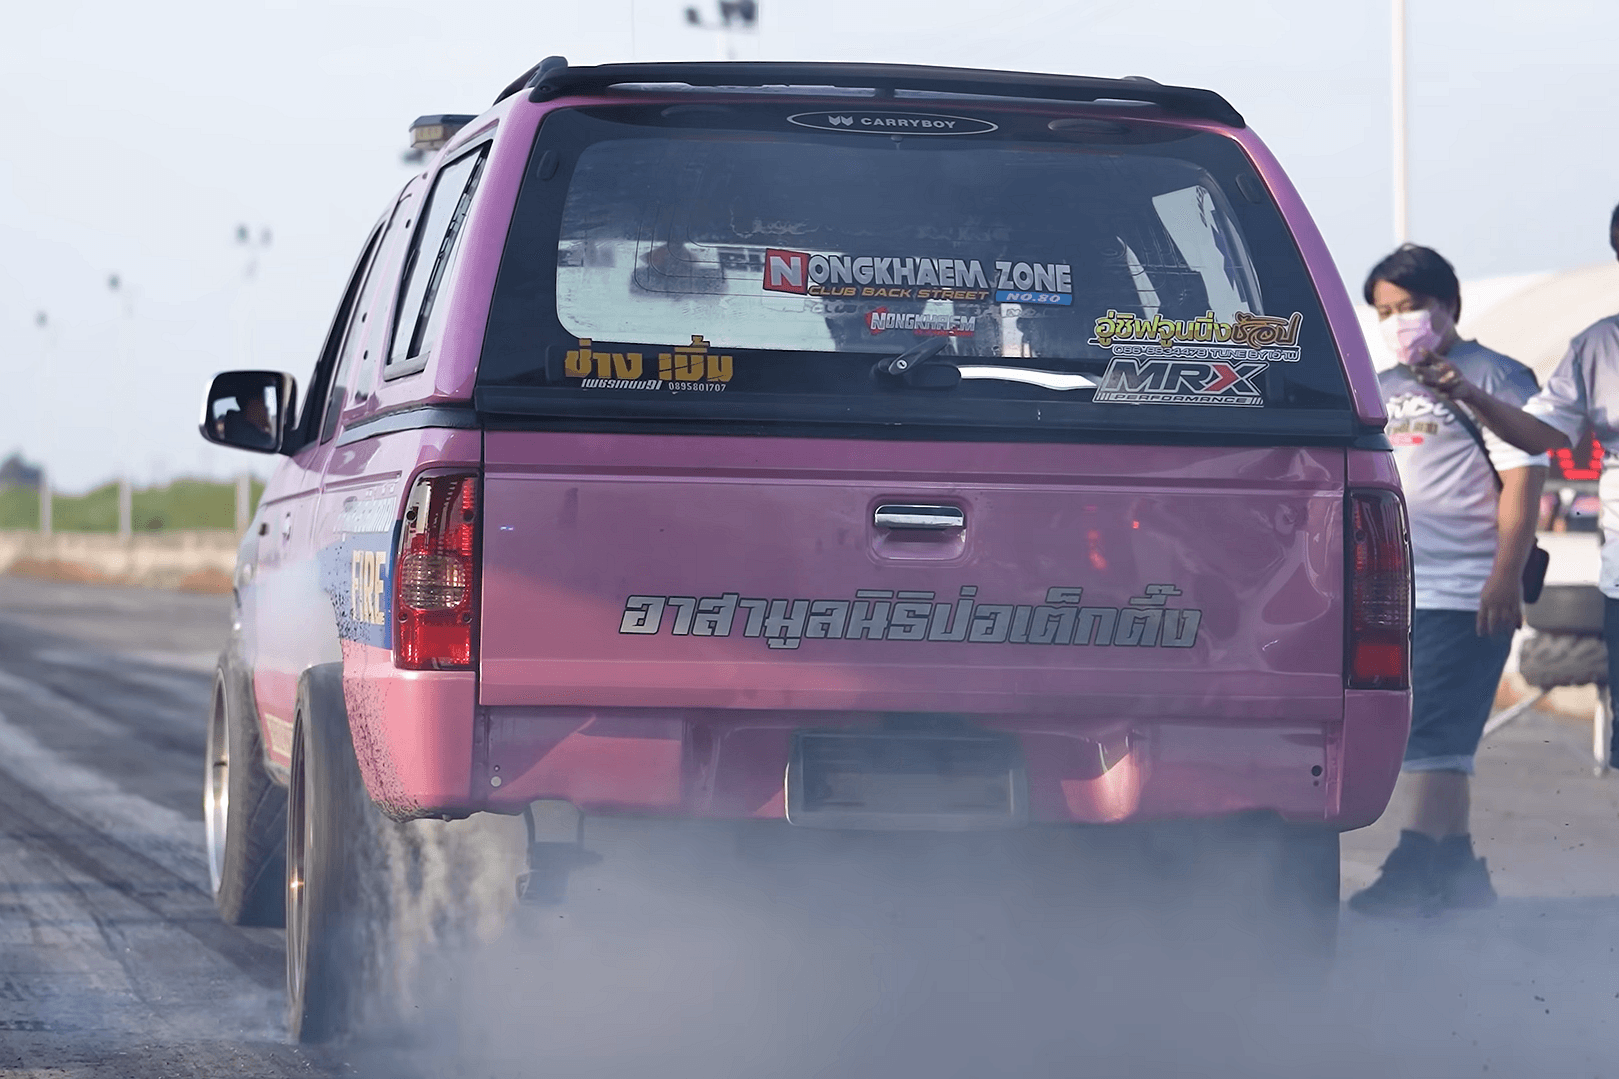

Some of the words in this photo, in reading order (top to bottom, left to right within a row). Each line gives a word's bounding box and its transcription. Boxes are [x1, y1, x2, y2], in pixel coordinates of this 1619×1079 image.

[860, 116, 956, 130] CARRYBOY
[766, 253, 990, 290] NONGKHAEM
[995, 260, 1072, 293] ZONE
[808, 285, 857, 296] CLUB
[862, 287, 912, 299] BACK
[917, 288, 989, 300] STREET
[1006, 292, 1061, 303] NO.80
[869, 311, 976, 332] NONGKHAEM
[564, 338, 643, 379] ช่าง
[1211, 349, 1246, 359] TUNE
[1248, 350, 1268, 360] BY
[1101, 359, 1263, 395] MRX
[668, 382, 727, 393] 0895801707
[1114, 393, 1248, 404] PERFORMANCE
[352, 549, 387, 626] FIRE
